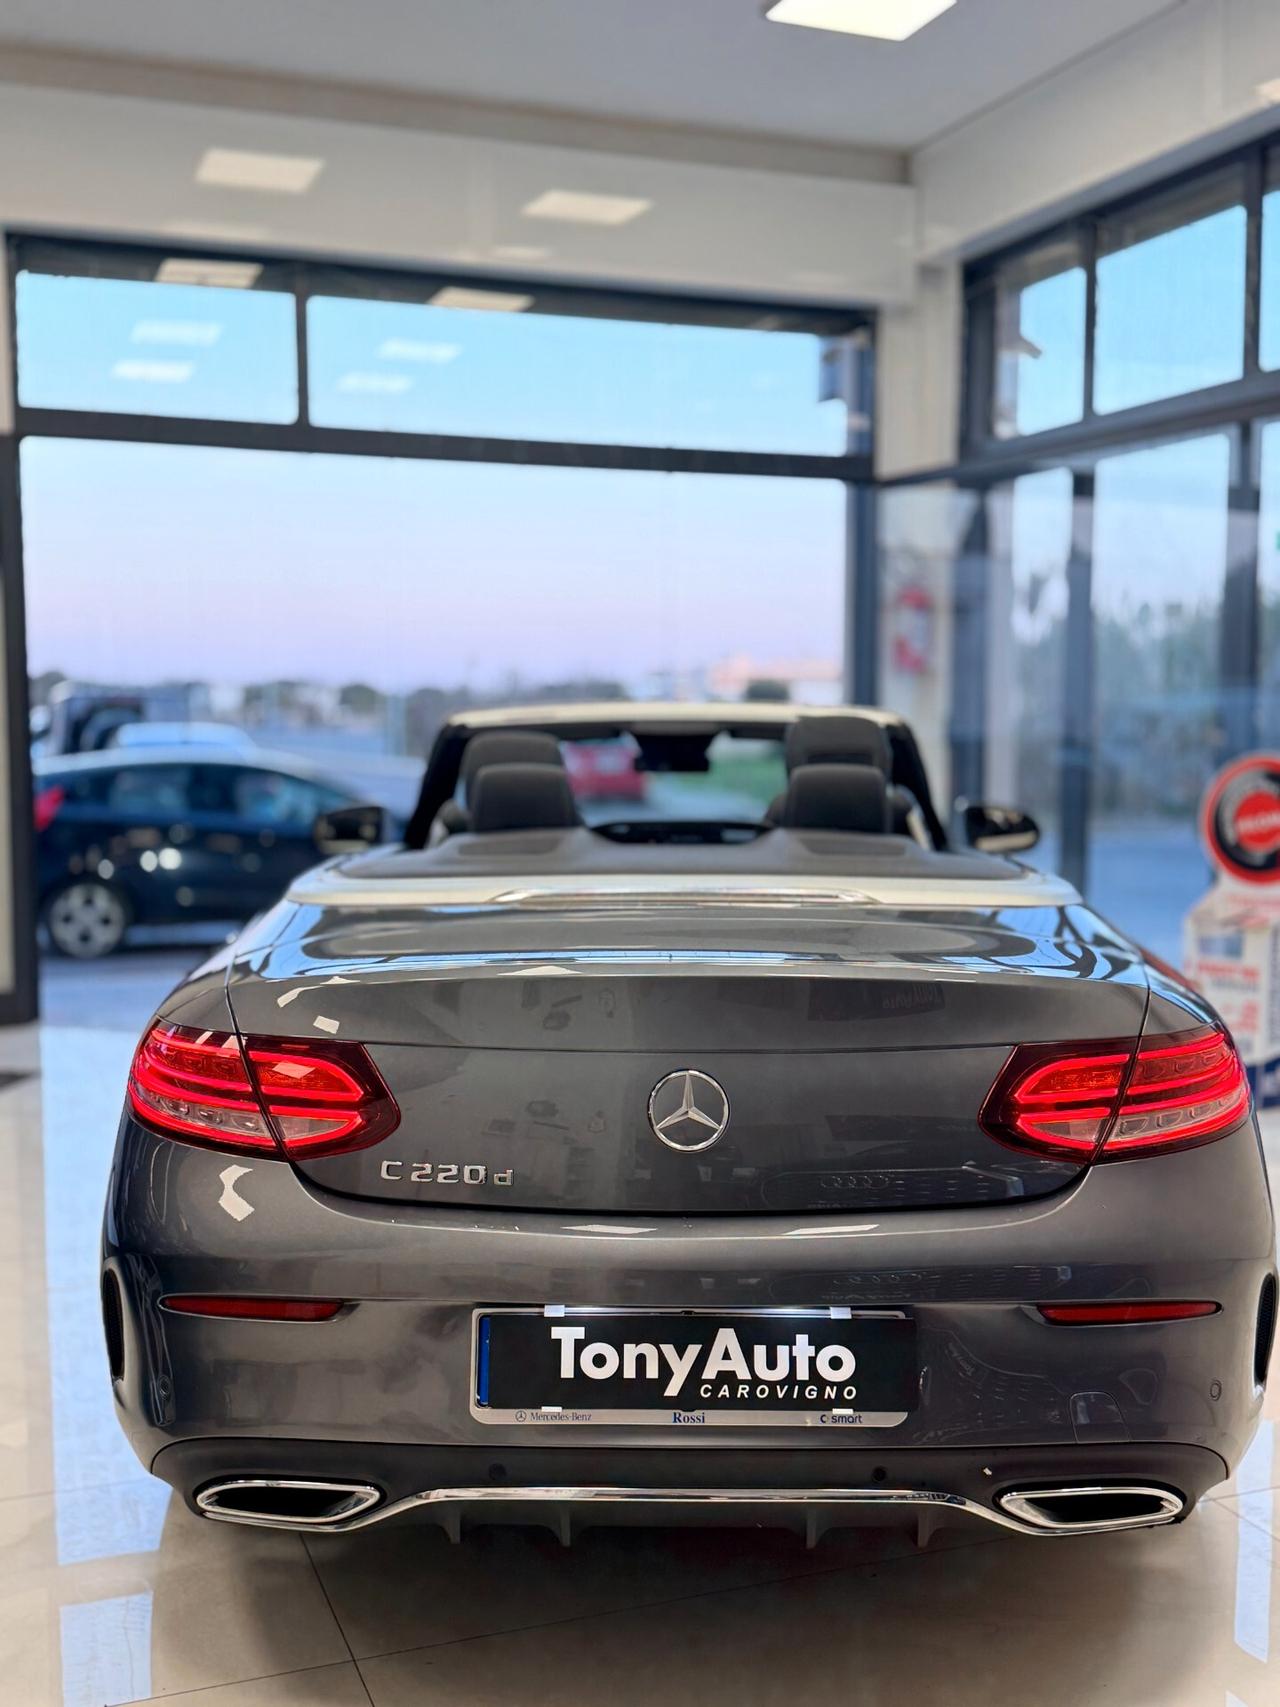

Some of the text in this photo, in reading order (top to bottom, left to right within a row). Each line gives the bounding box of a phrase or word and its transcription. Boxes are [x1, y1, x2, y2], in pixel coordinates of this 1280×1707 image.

[380, 1160, 514, 1186] C 220 d
[551, 1326, 856, 1397] TonyAuto
[700, 1384, 857, 1400] CAROVIGNO
[530, 1412, 592, 1422] Mercedes-Benz
[672, 1411, 705, 1424] Rossi
[831, 1414, 863, 1425] smart
